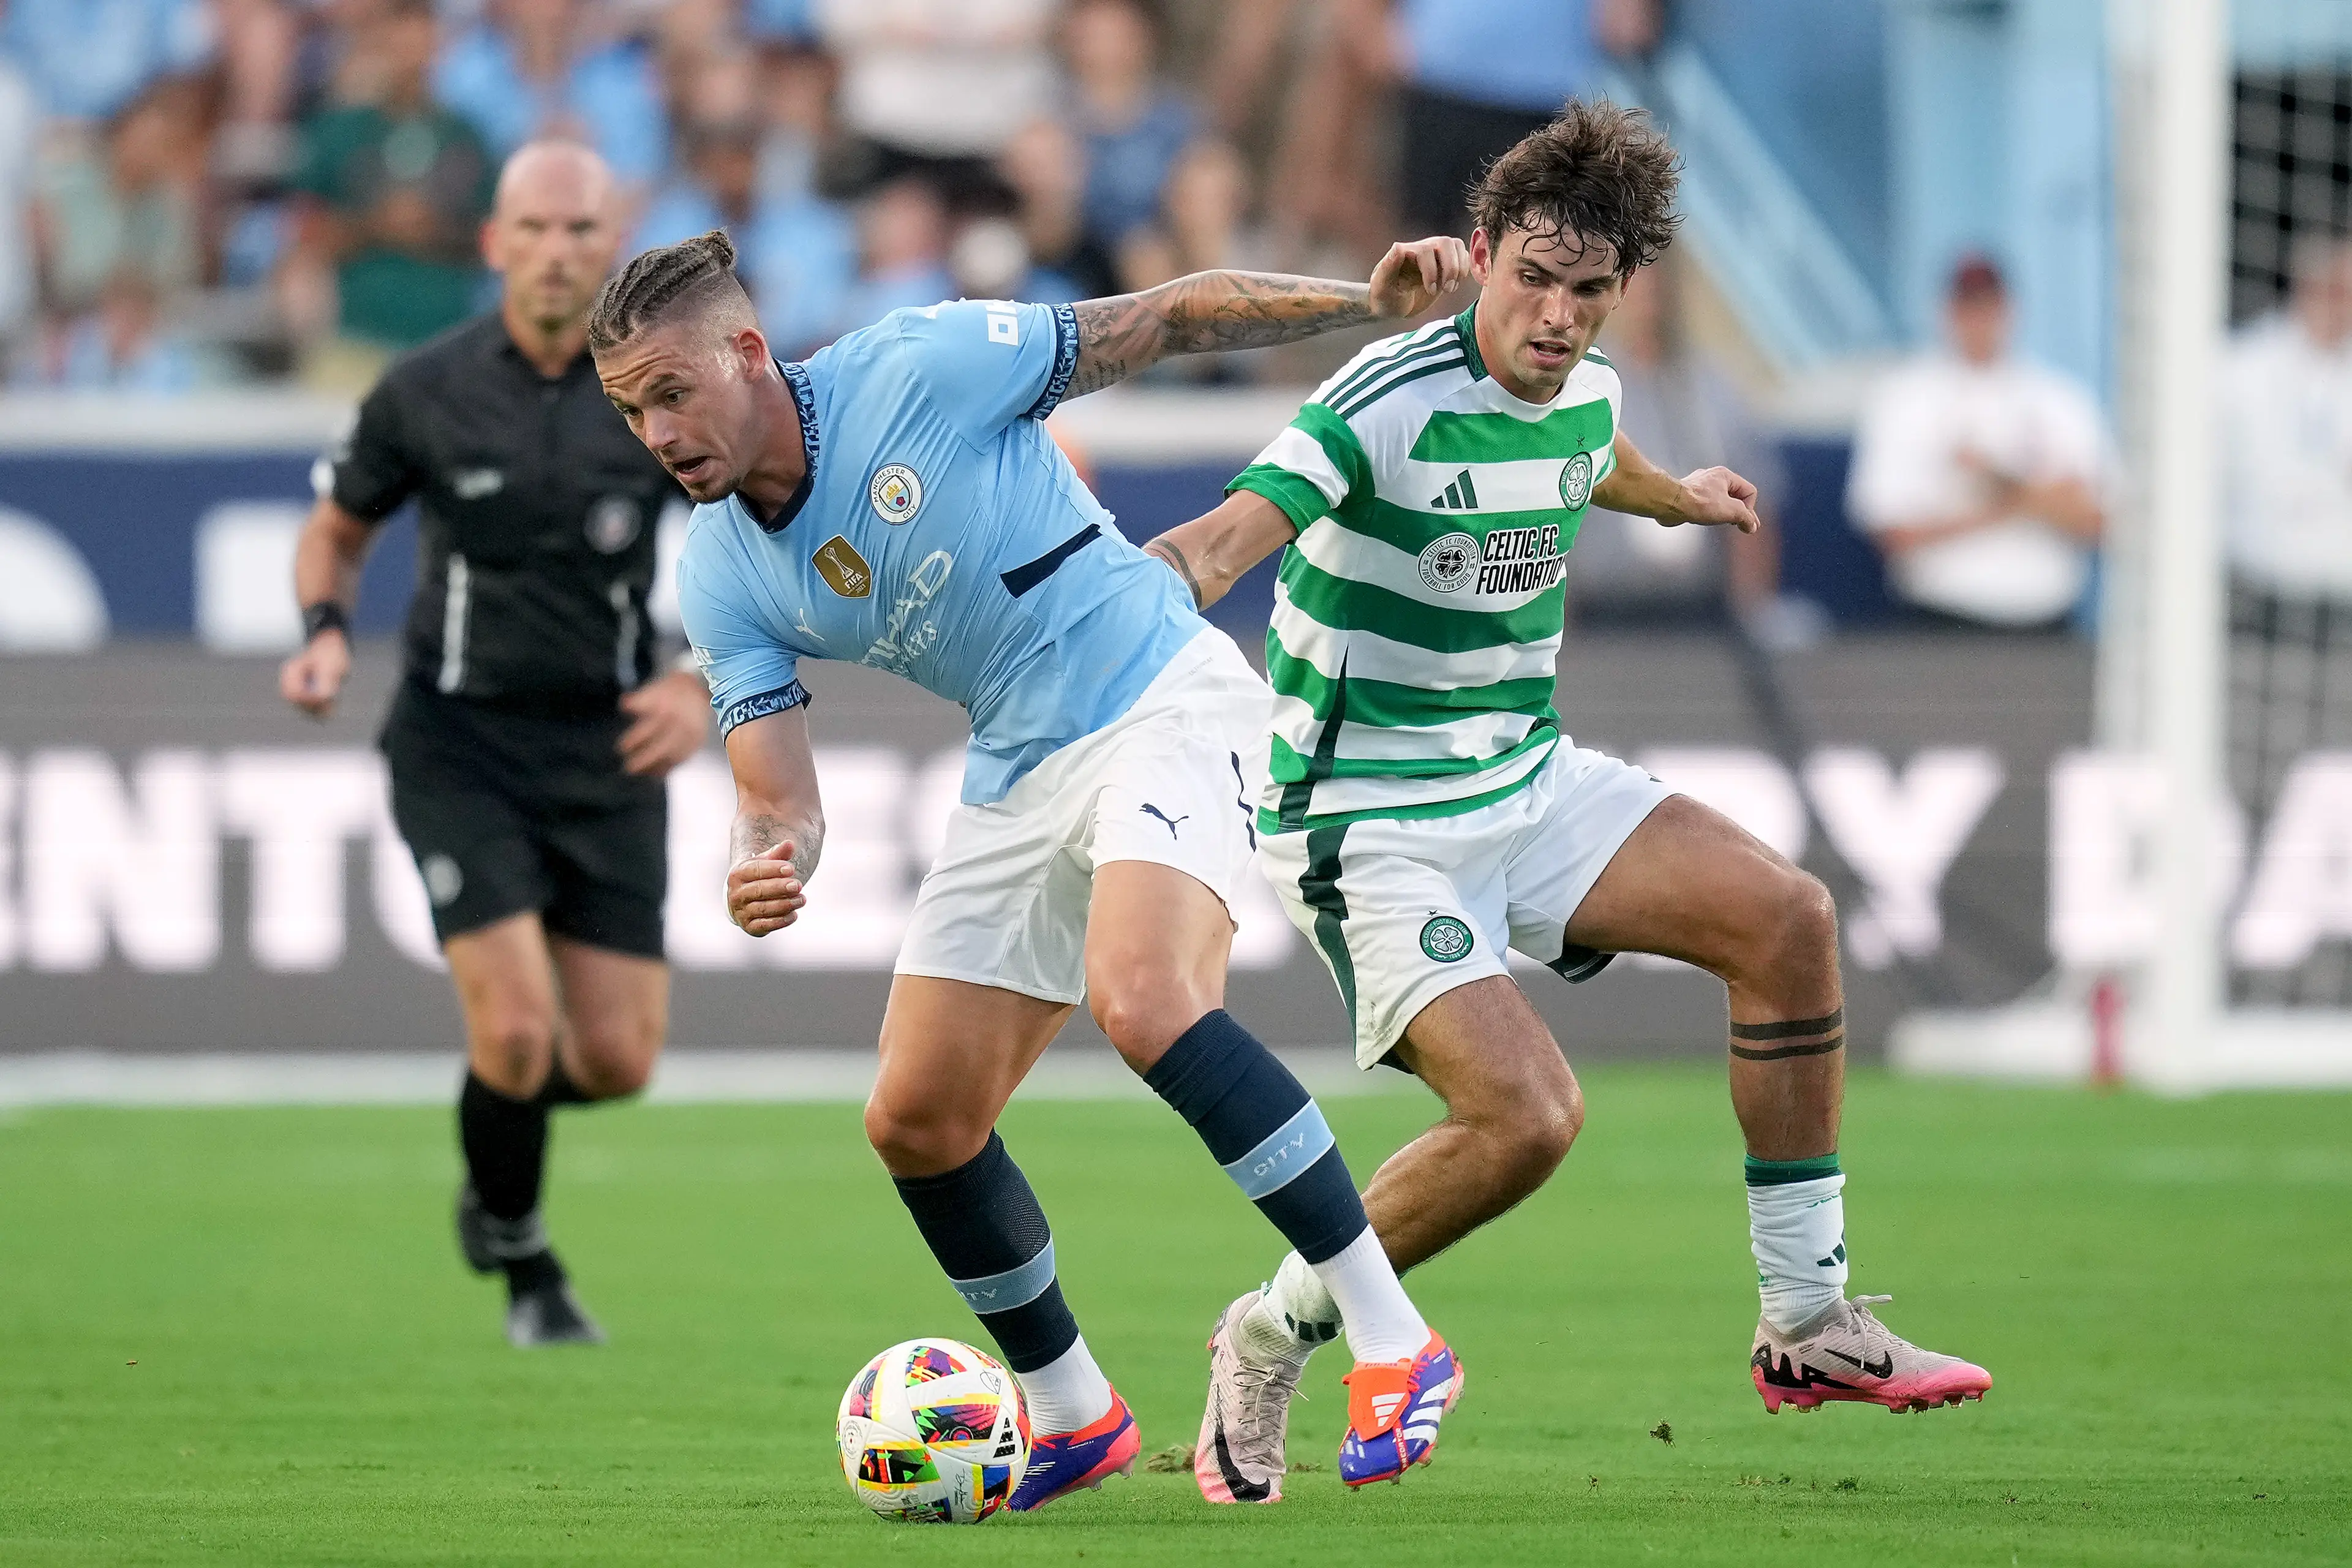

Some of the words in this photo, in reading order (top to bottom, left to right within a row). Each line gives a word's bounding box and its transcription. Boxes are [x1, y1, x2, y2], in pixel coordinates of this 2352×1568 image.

[873, 468, 905, 502] MANCHESTER
[902, 504, 916, 519] CITY
[1426, 541, 1444, 558] CELTIC
[1483, 529, 1537, 562] CELTIC
[1539, 526, 1558, 557] FC
[845, 573, 863, 589] FIFA
[1422, 569, 1442, 590] FOOTBALL
[1457, 573, 1471, 587] GOOD
[1475, 554, 1566, 595] FOUNDATIO
[1253, 1132, 1304, 1177] CITY
[959, 1287, 998, 1302] ITY
